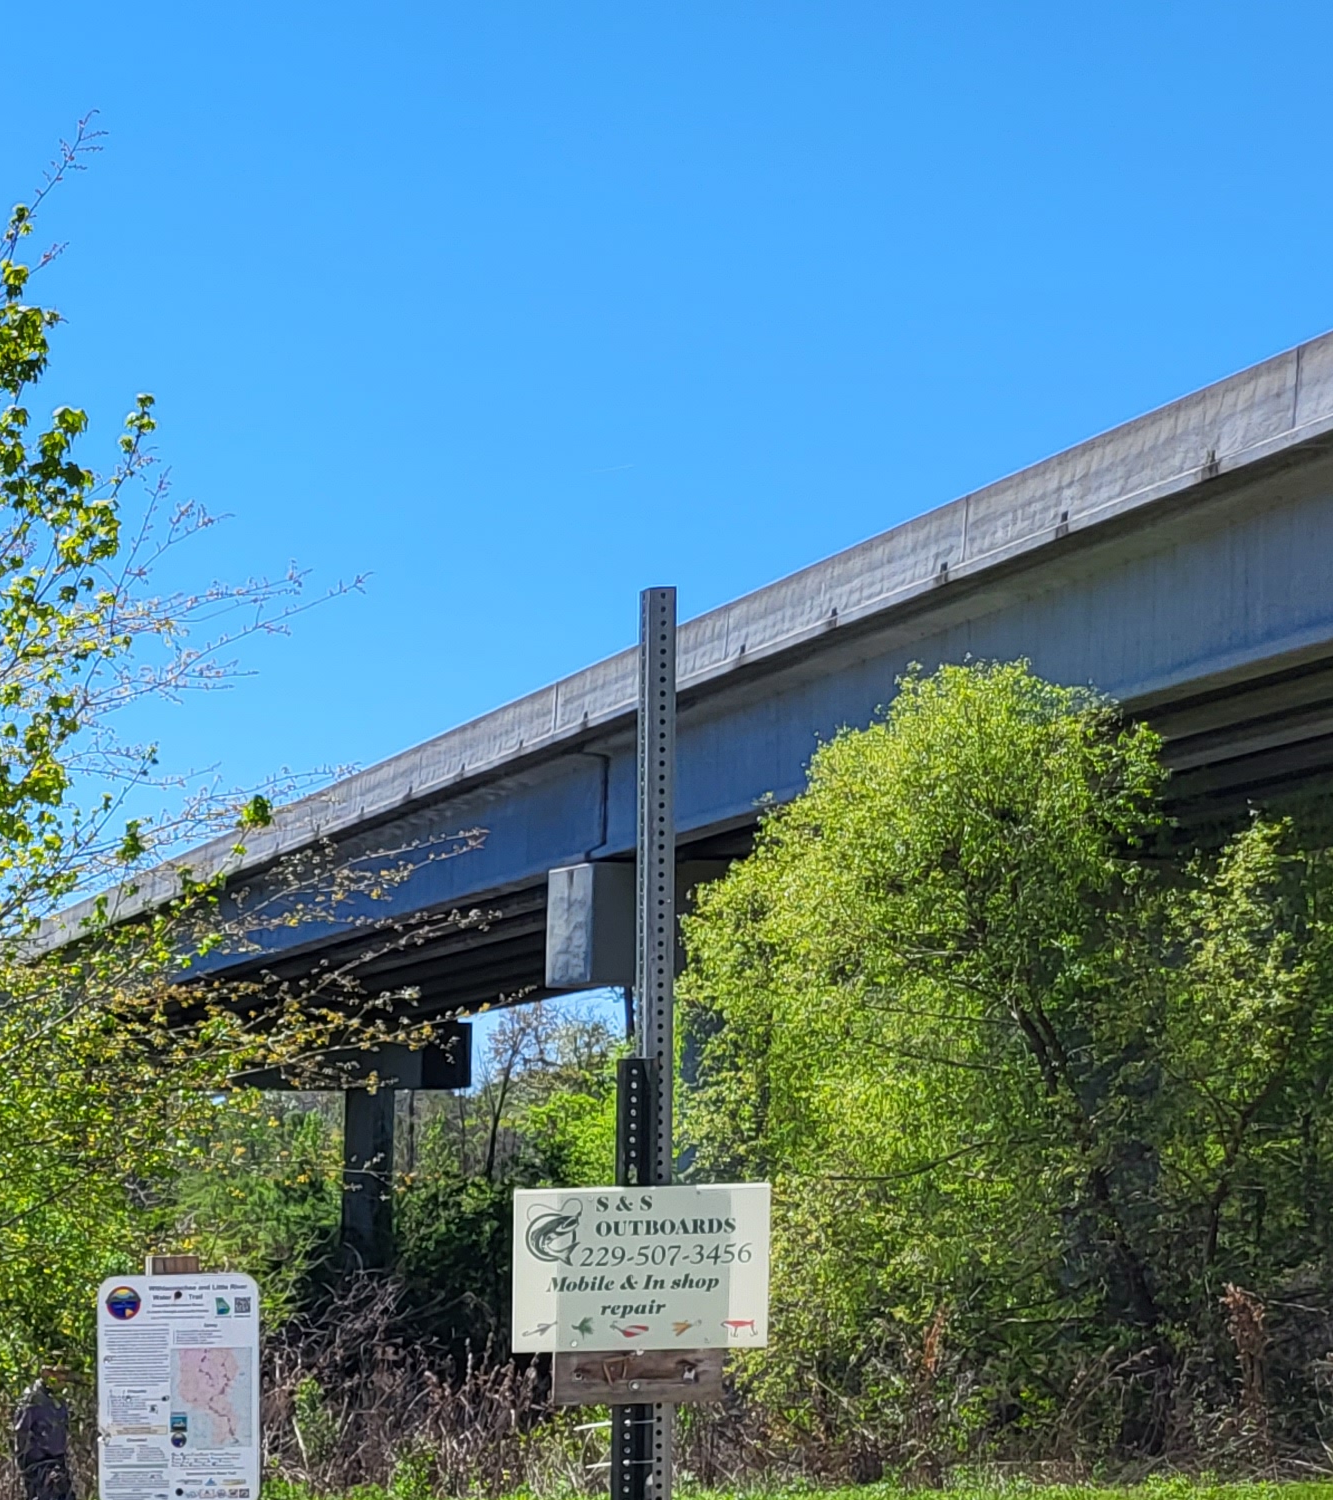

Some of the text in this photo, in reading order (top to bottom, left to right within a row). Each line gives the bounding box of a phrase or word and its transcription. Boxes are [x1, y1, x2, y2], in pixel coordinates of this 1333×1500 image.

[596, 1195, 653, 1212] S & S
[595, 1217, 737, 1238] OUTBOARDS
[580, 1243, 753, 1267] 229-507-3456
[546, 1273, 720, 1293] Mobile & In shop
[600, 1300, 667, 1318] repair
